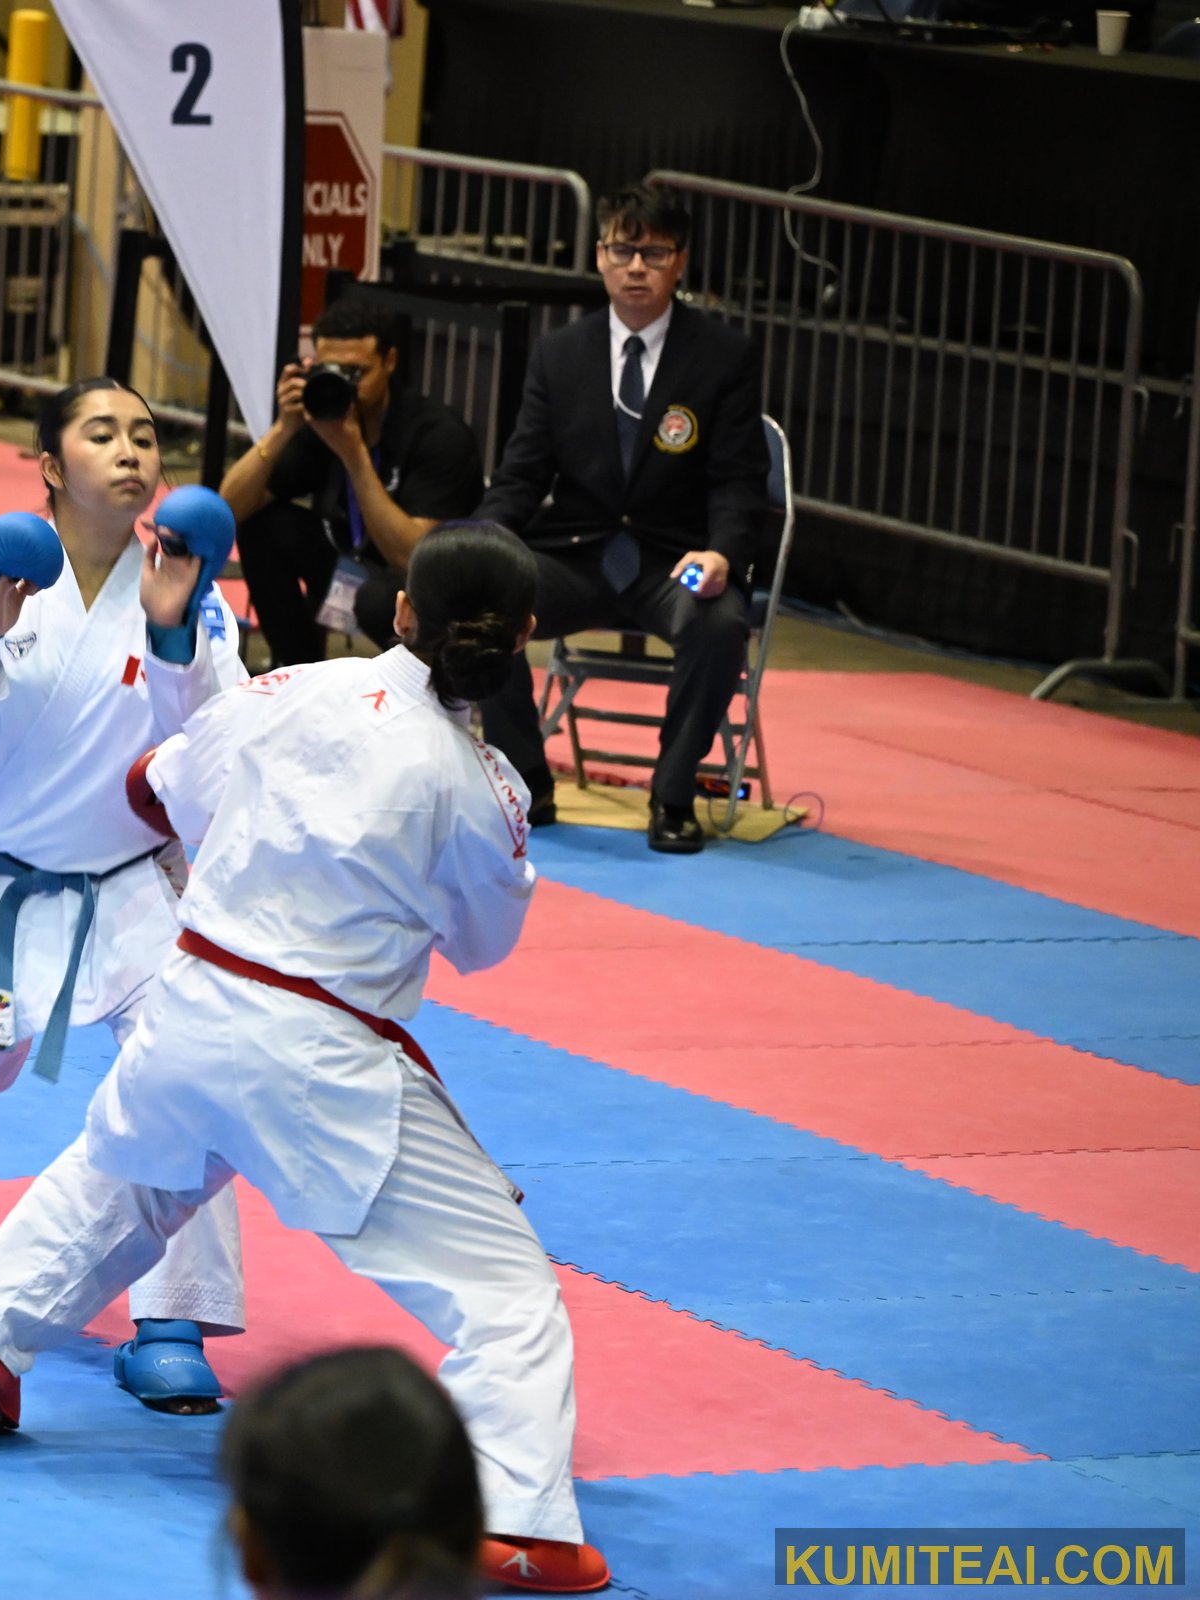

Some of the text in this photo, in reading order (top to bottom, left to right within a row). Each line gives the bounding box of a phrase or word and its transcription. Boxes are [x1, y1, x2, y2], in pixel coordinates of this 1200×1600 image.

[170, 42, 213, 126] 2
[303, 182, 368, 215] ICIALS
[302, 233, 345, 268] NLY
